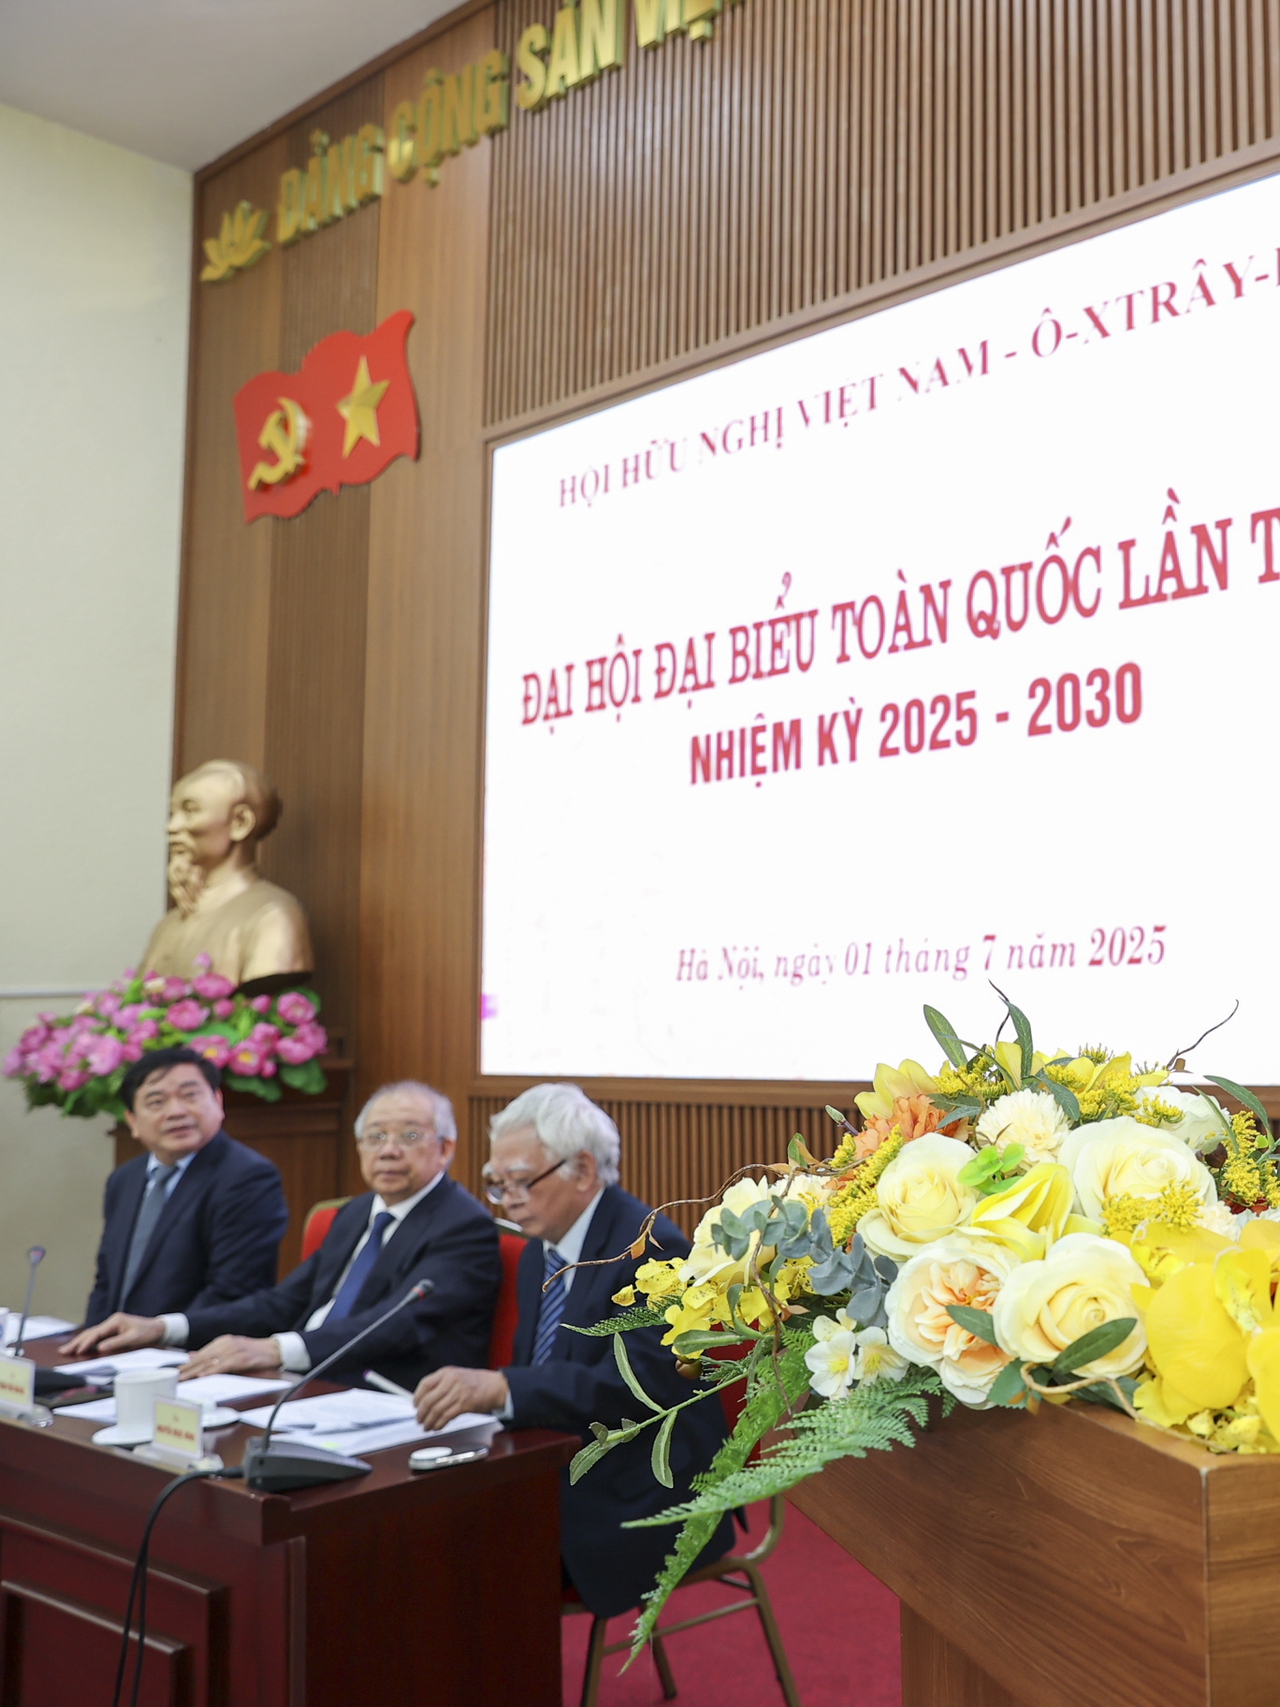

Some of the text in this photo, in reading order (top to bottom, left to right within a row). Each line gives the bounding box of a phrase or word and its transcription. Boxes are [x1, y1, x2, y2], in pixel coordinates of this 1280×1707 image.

[277, 123, 384, 246] ĐẢNG
[387, 49, 510, 188] CỘNG
[560, 464, 610, 508] HỘI
[622, 437, 687, 489] HỮU
[698, 406, 783, 463] NGHỊ
[797, 373, 884, 428] VIỆT
[897, 340, 989, 402] NAM
[521, 663, 575, 735] ĐẠI
[585, 633, 643, 722] HỘI
[654, 631, 716, 709] ĐẠI
[728, 571, 819, 685] BIỂU
[831, 569, 953, 665] TOÀN
[966, 516, 1102, 641] QUỐC
[1117, 487, 1234, 611] LẦN
[690, 661, 1143, 788] NHIỆM KỲ 2025 - 2030
[677, 948, 709, 981] Hà
[774, 942, 836, 986] ngày
[845, 941, 872, 976] 01
[885, 938, 970, 981] tháng
[983, 934, 997, 971] 7
[1007, 931, 1076, 970] năm
[1088, 924, 1167, 967] 2025
